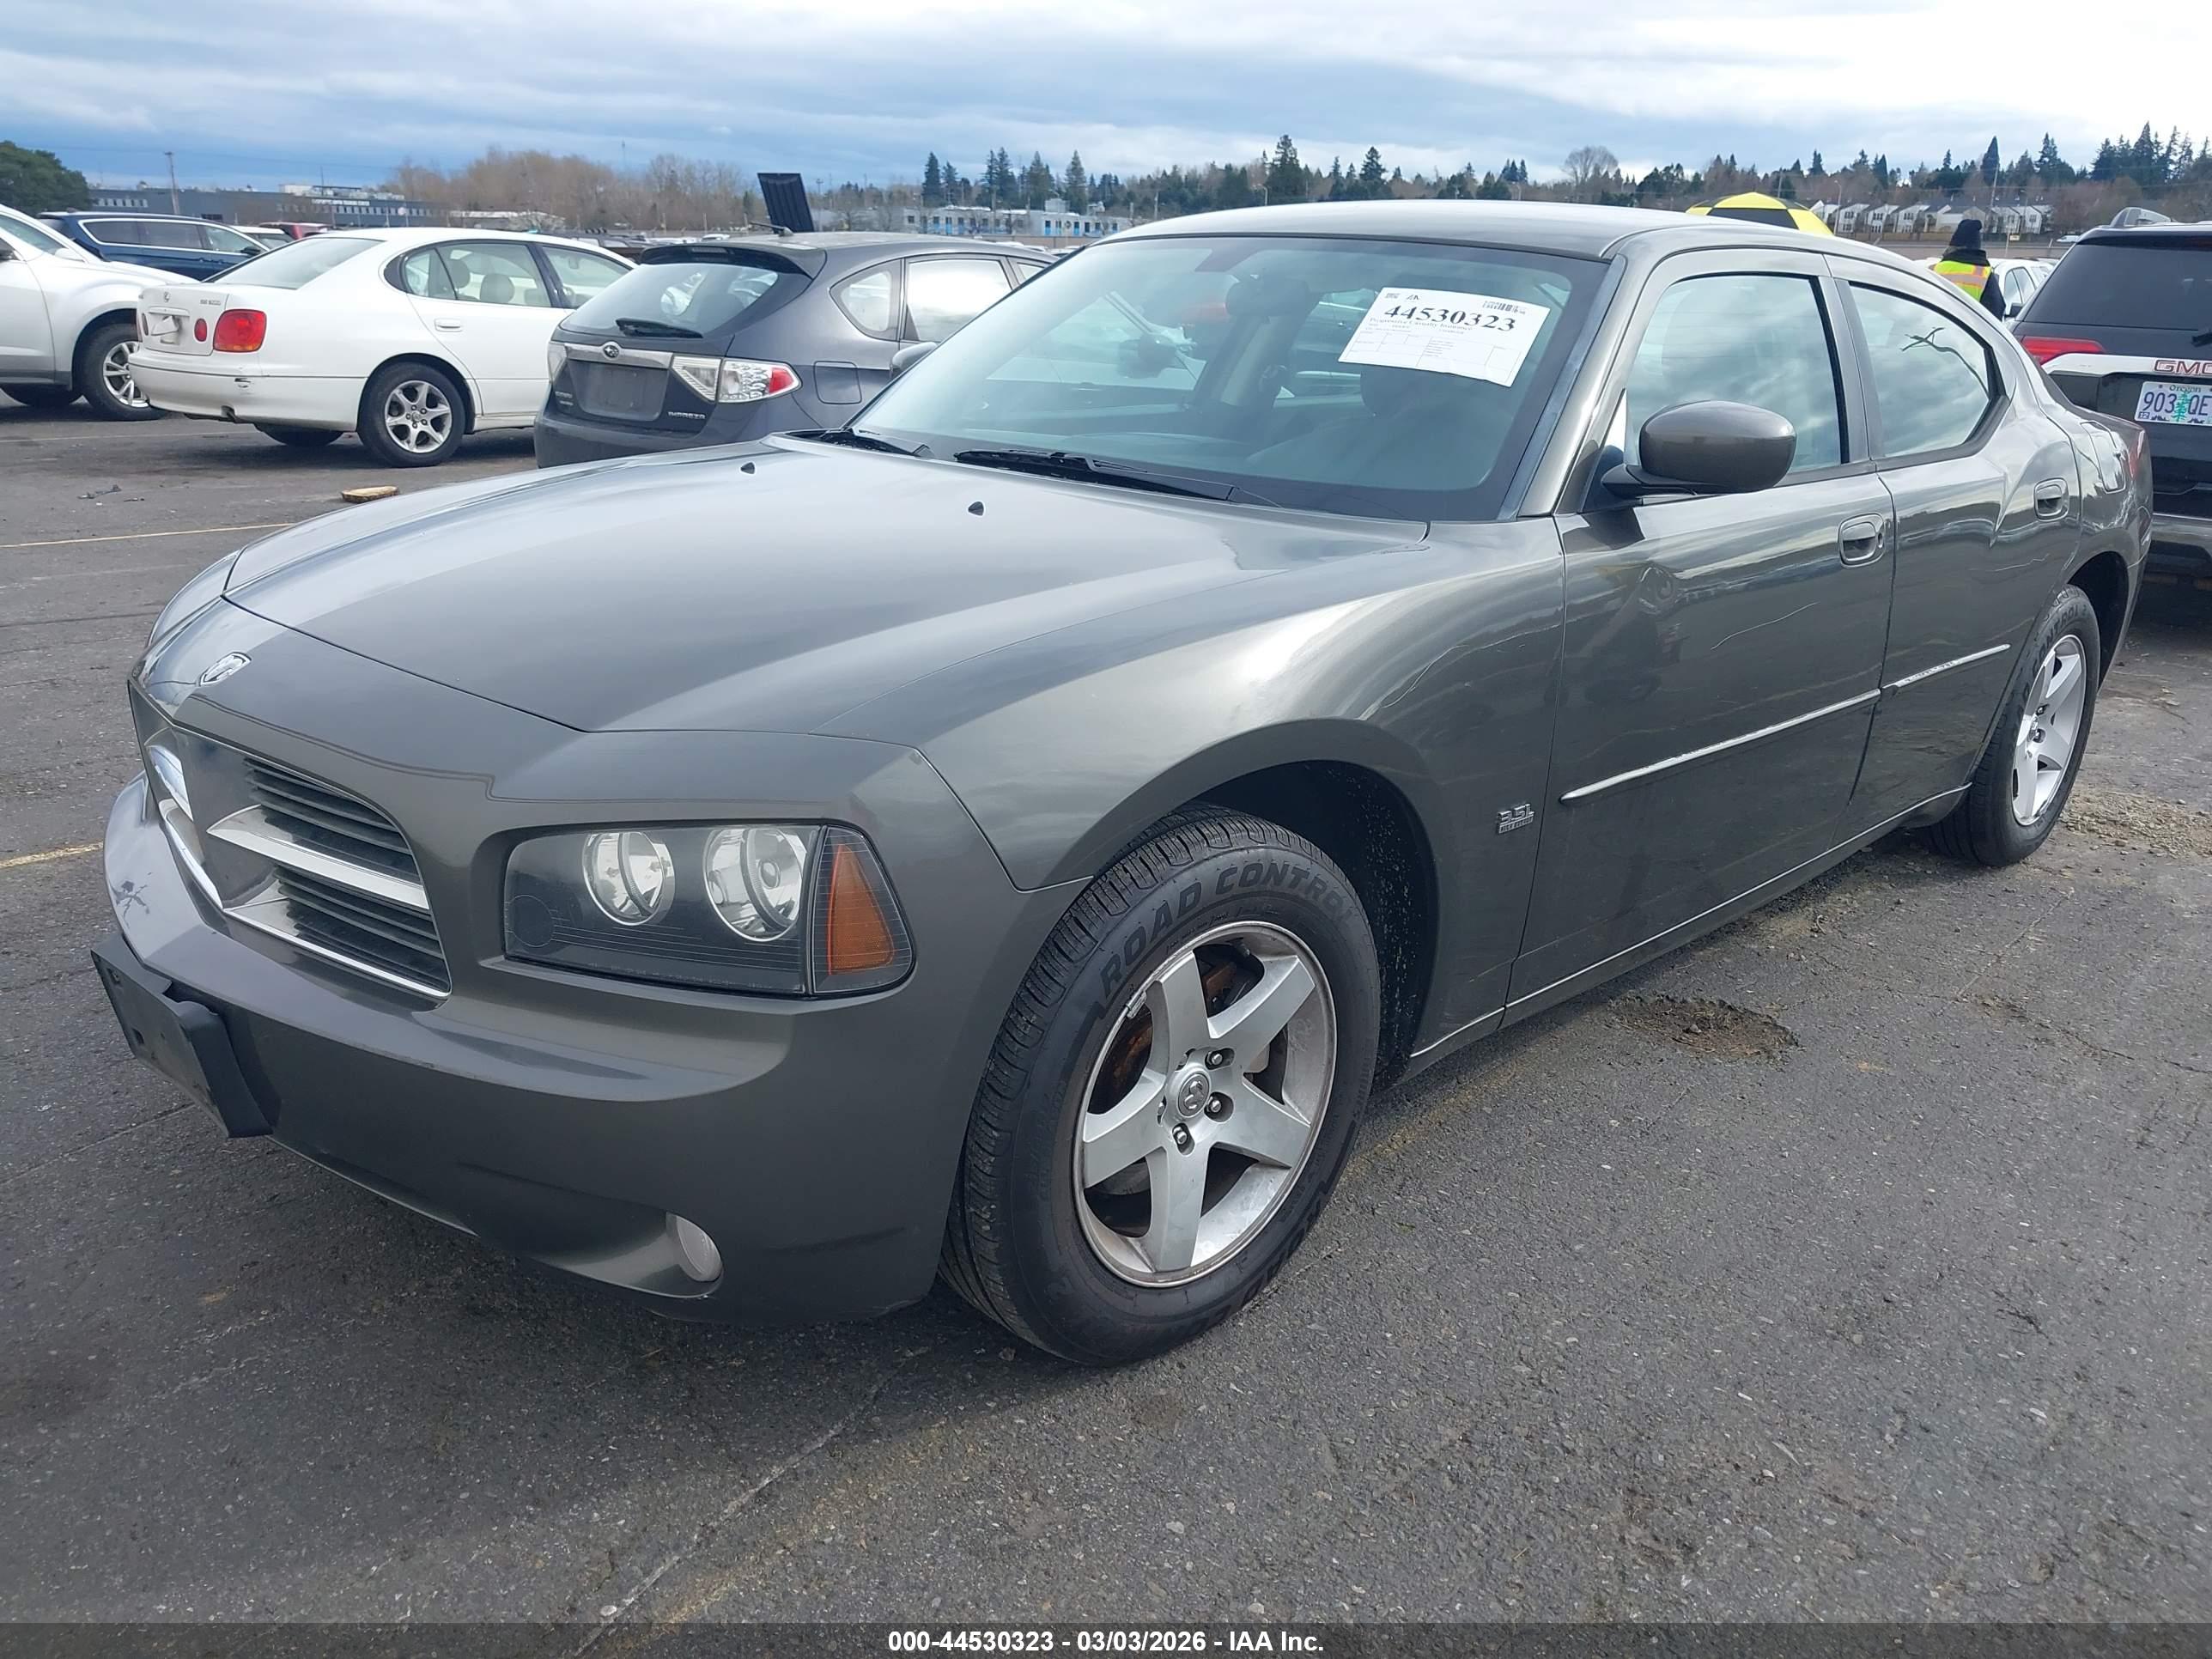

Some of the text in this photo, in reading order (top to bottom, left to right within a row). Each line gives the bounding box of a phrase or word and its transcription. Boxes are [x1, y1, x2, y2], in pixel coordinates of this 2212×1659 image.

[1384, 305, 1516, 332] 44530323
[2169, 384, 2202, 394] Oregon
[2142, 391, 2178, 414] 903
[1099, 880, 1203, 999] ROAD
[1214, 860, 1357, 923] CONTROL
